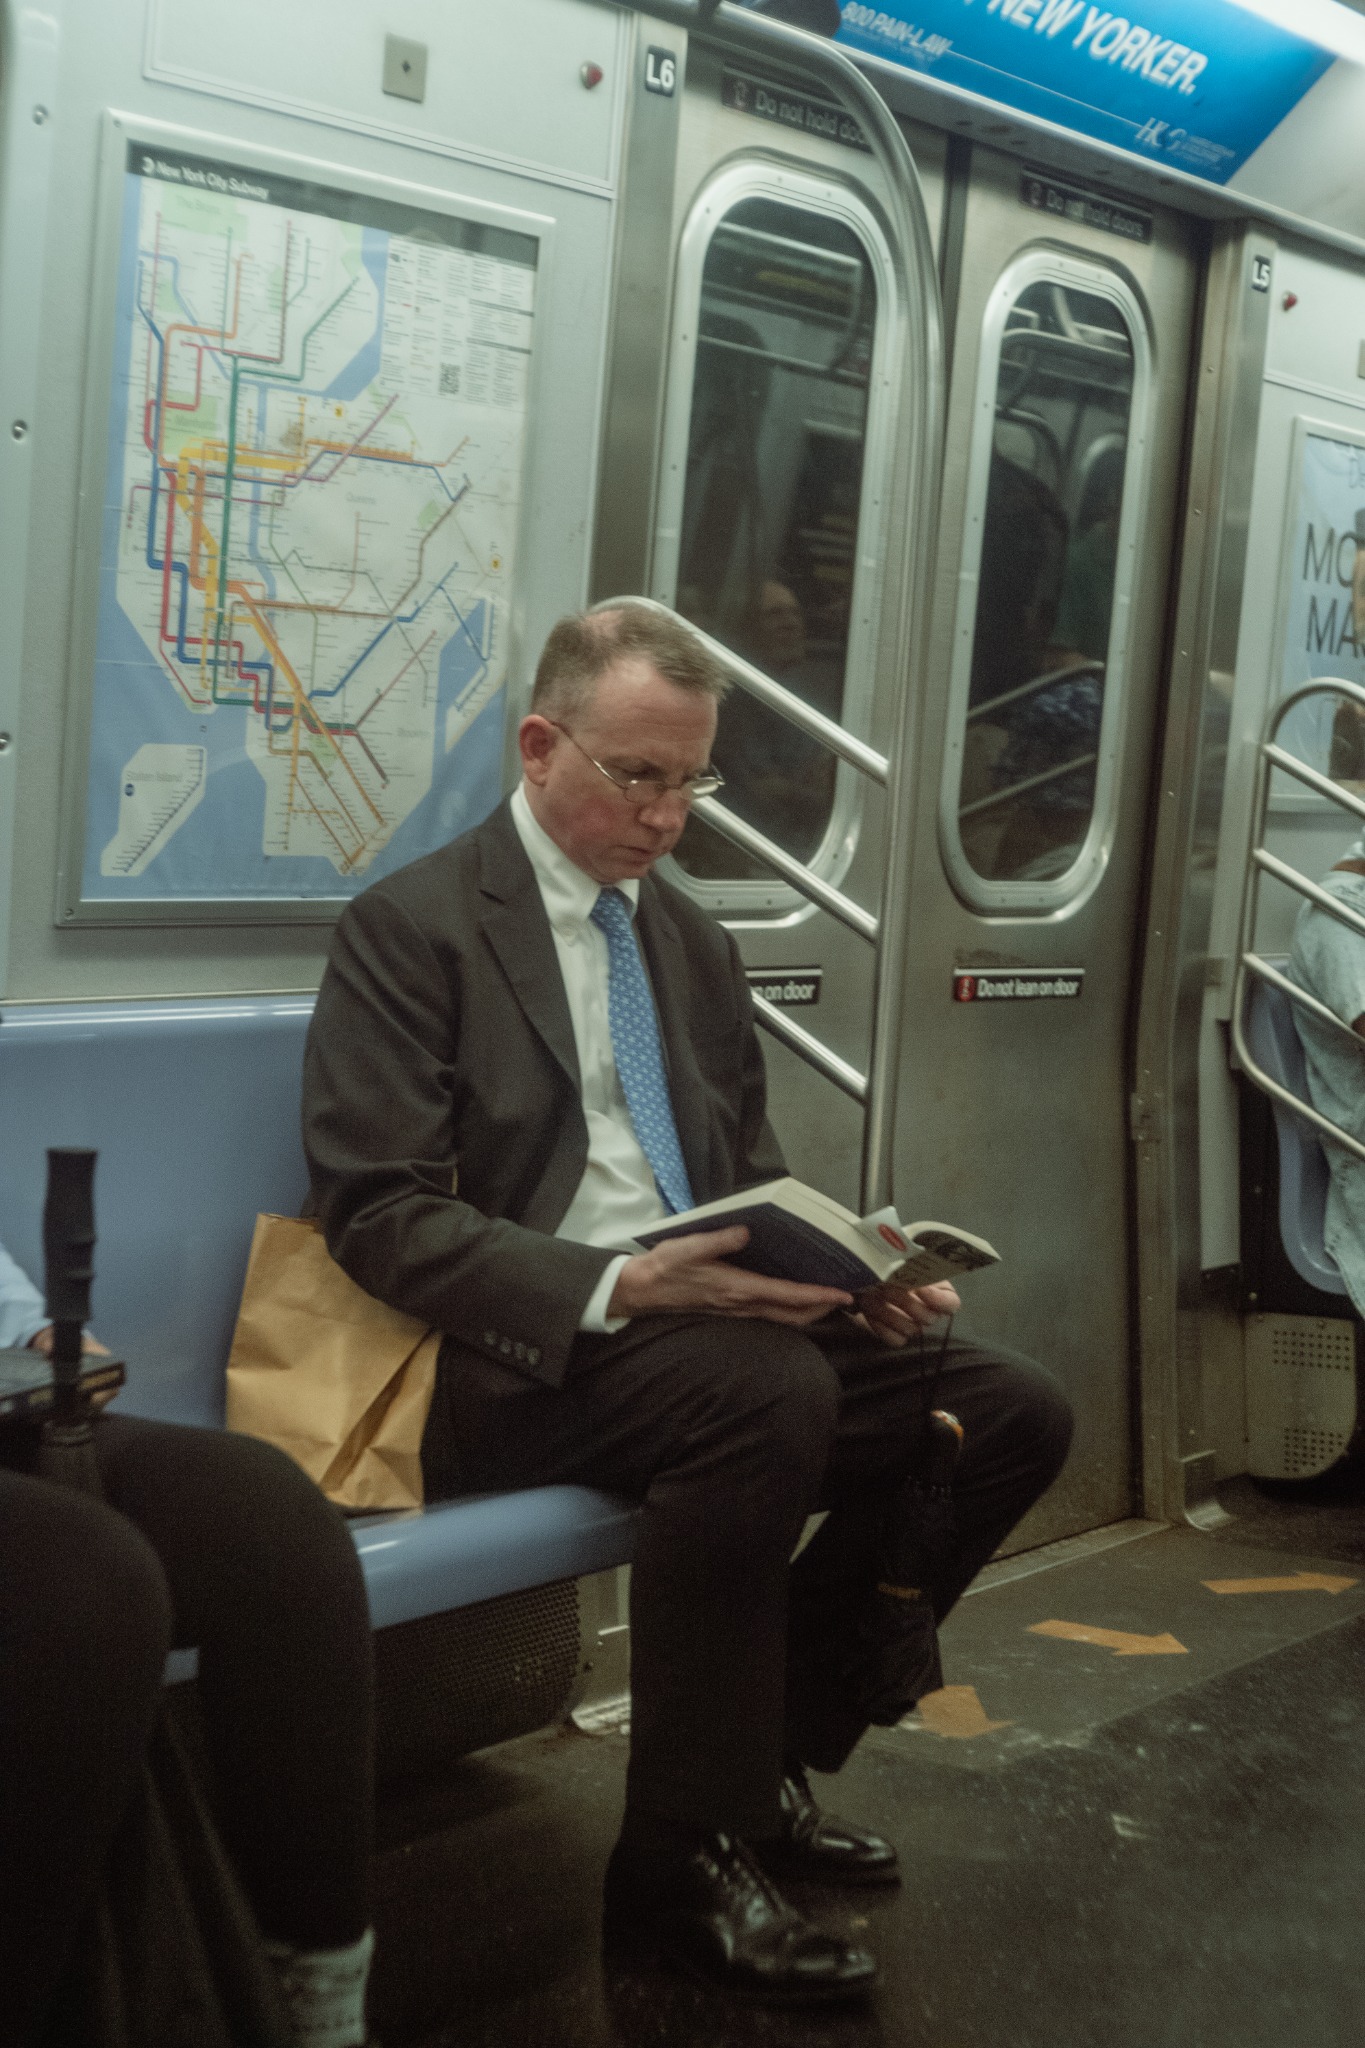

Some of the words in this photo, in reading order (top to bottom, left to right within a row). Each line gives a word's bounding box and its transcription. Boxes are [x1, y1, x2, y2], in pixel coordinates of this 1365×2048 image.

[1072, 6, 1209, 96] YORKER.
[646, 53, 675, 90] L6
[755, 90, 777, 115] Do
[1252, 259, 1271, 288] L5
[783, 980, 816, 1000] door
[977, 978, 995, 998] Do
[995, 978, 1014, 997] not
[1015, 977, 1039, 997] lean
[1039, 980, 1053, 996] on
[1053, 977, 1079, 996] door
